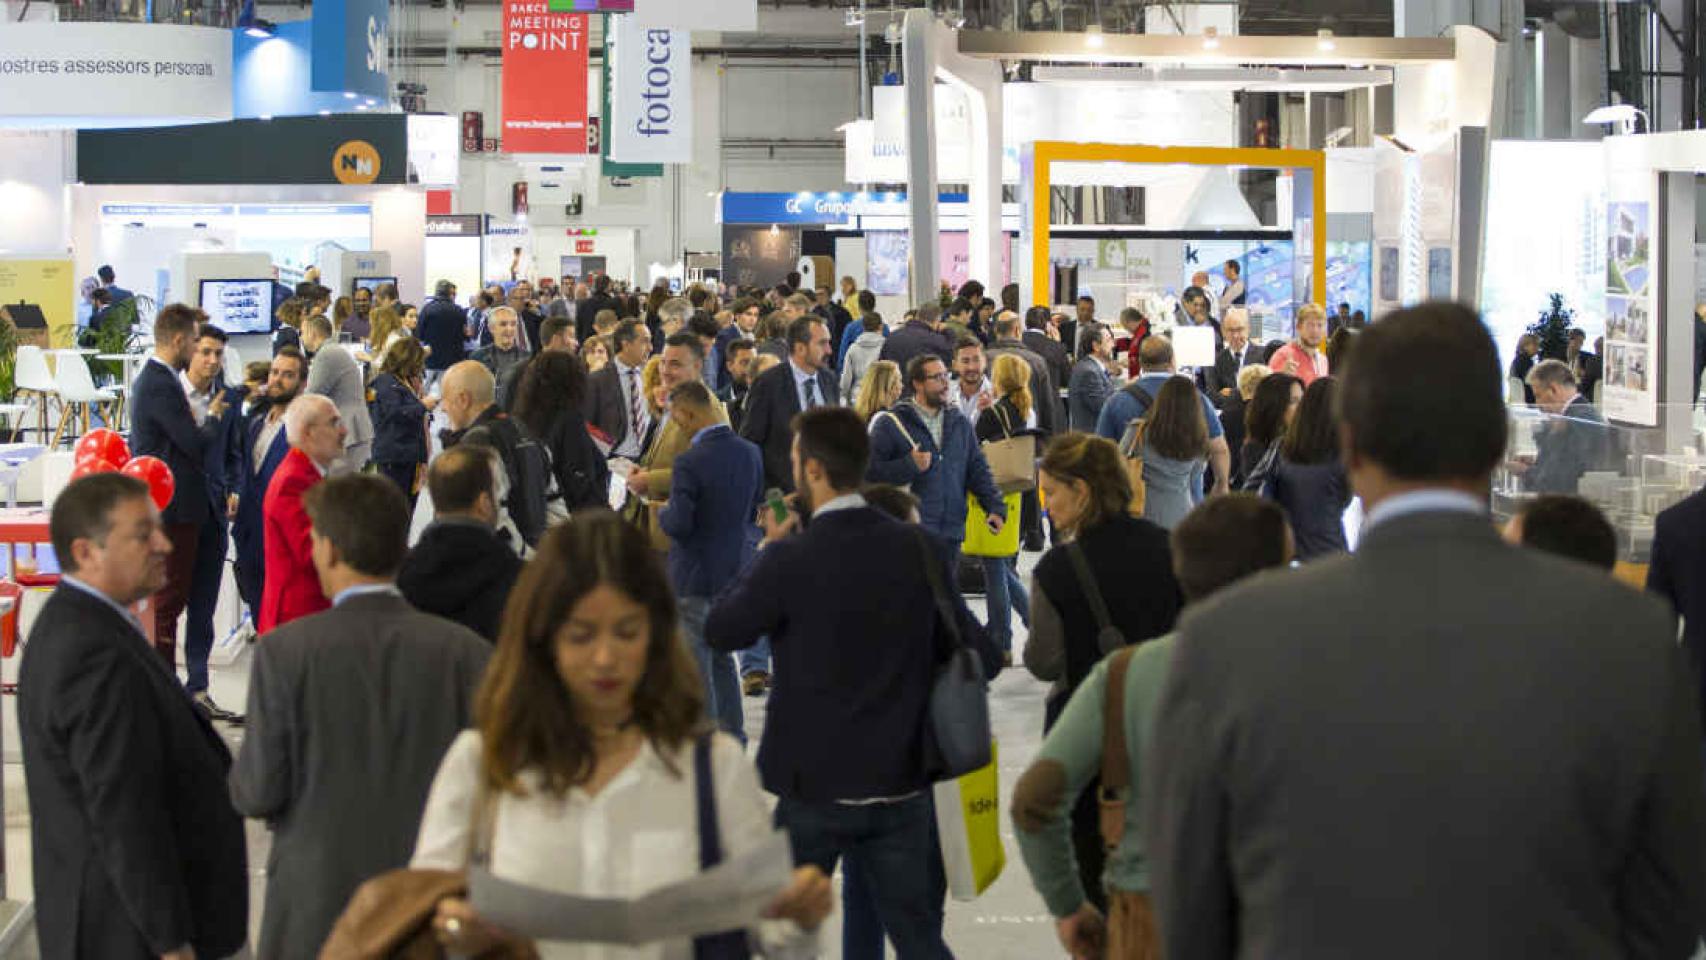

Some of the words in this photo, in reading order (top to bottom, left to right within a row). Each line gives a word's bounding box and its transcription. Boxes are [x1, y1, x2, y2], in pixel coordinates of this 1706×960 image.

[510, 17, 581, 29] MEETING
[510, 32, 581, 50] POINT
[64, 58, 150, 74] assessors
[636, 28, 671, 138] fotoca
